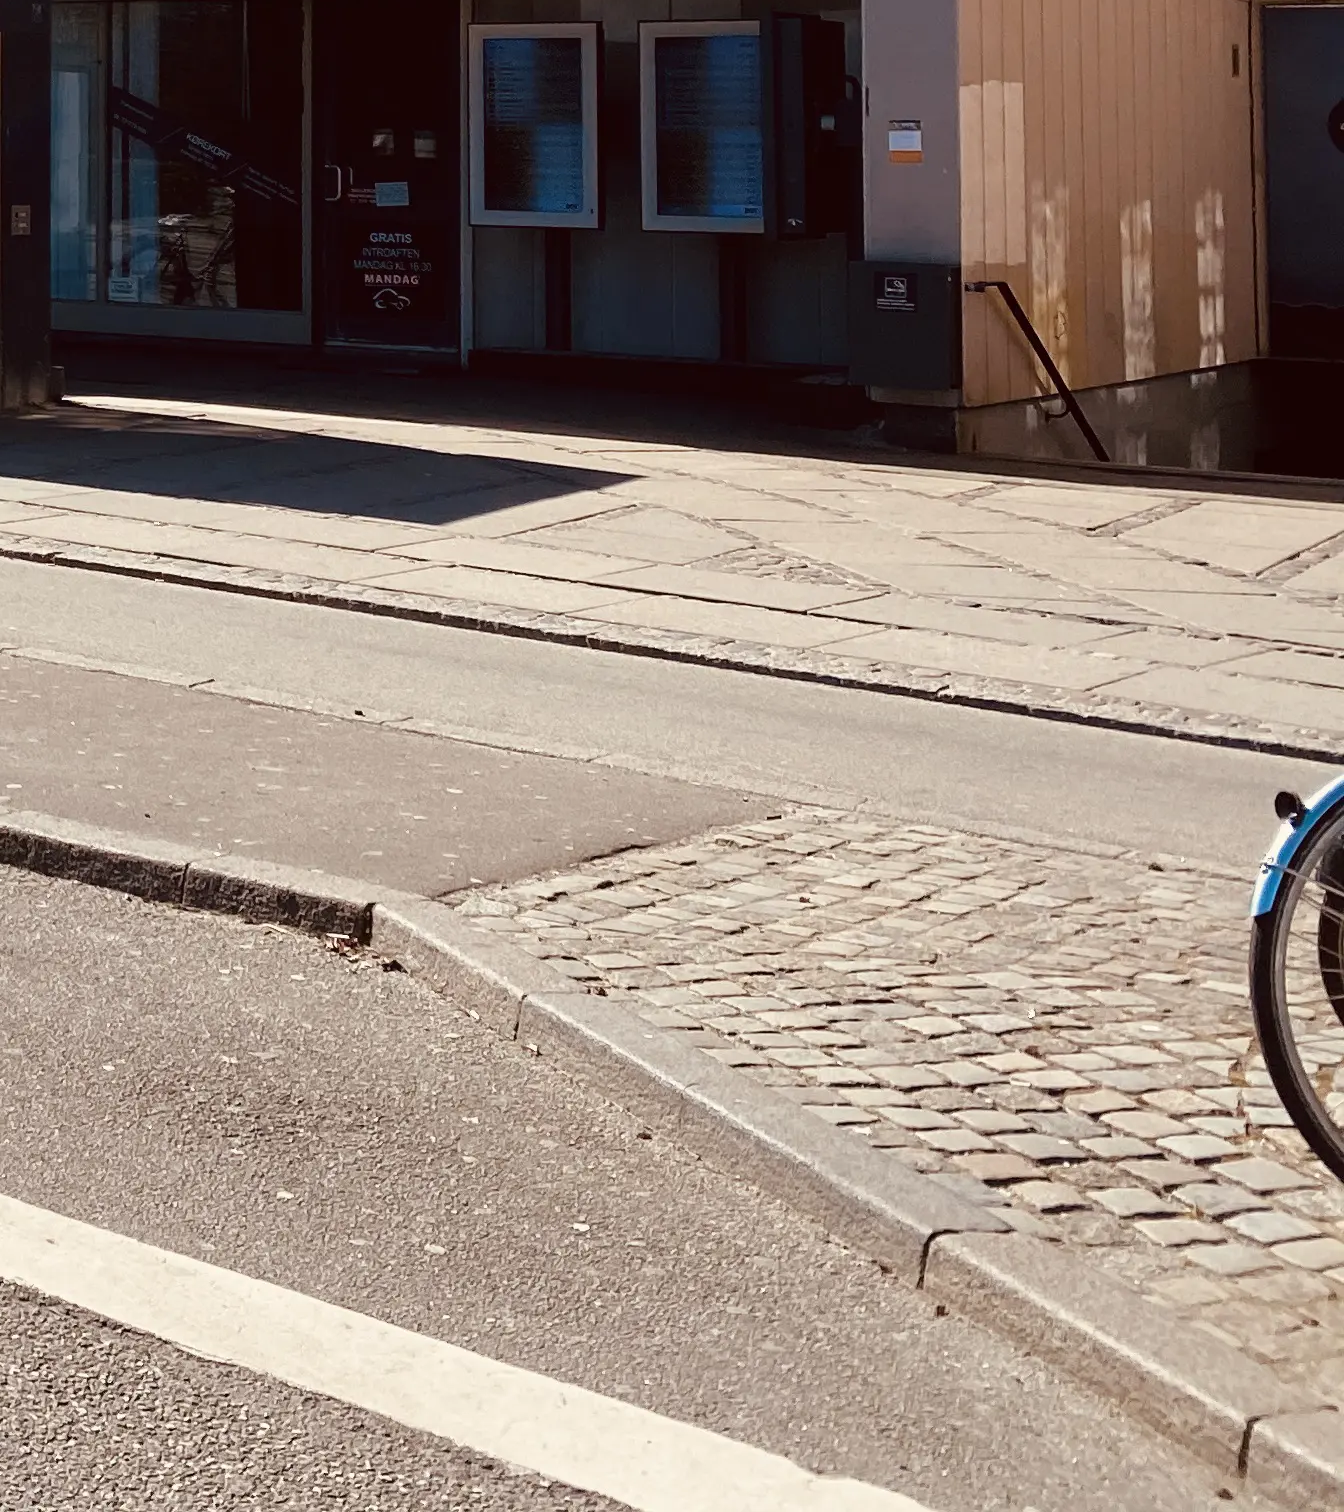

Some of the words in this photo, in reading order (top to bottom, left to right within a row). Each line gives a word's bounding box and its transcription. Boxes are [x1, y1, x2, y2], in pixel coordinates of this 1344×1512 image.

[369, 232, 413, 244] GRATIS
[362, 247, 421, 259] INTROAFTEN
[364, 273, 419, 285] MANDAG
